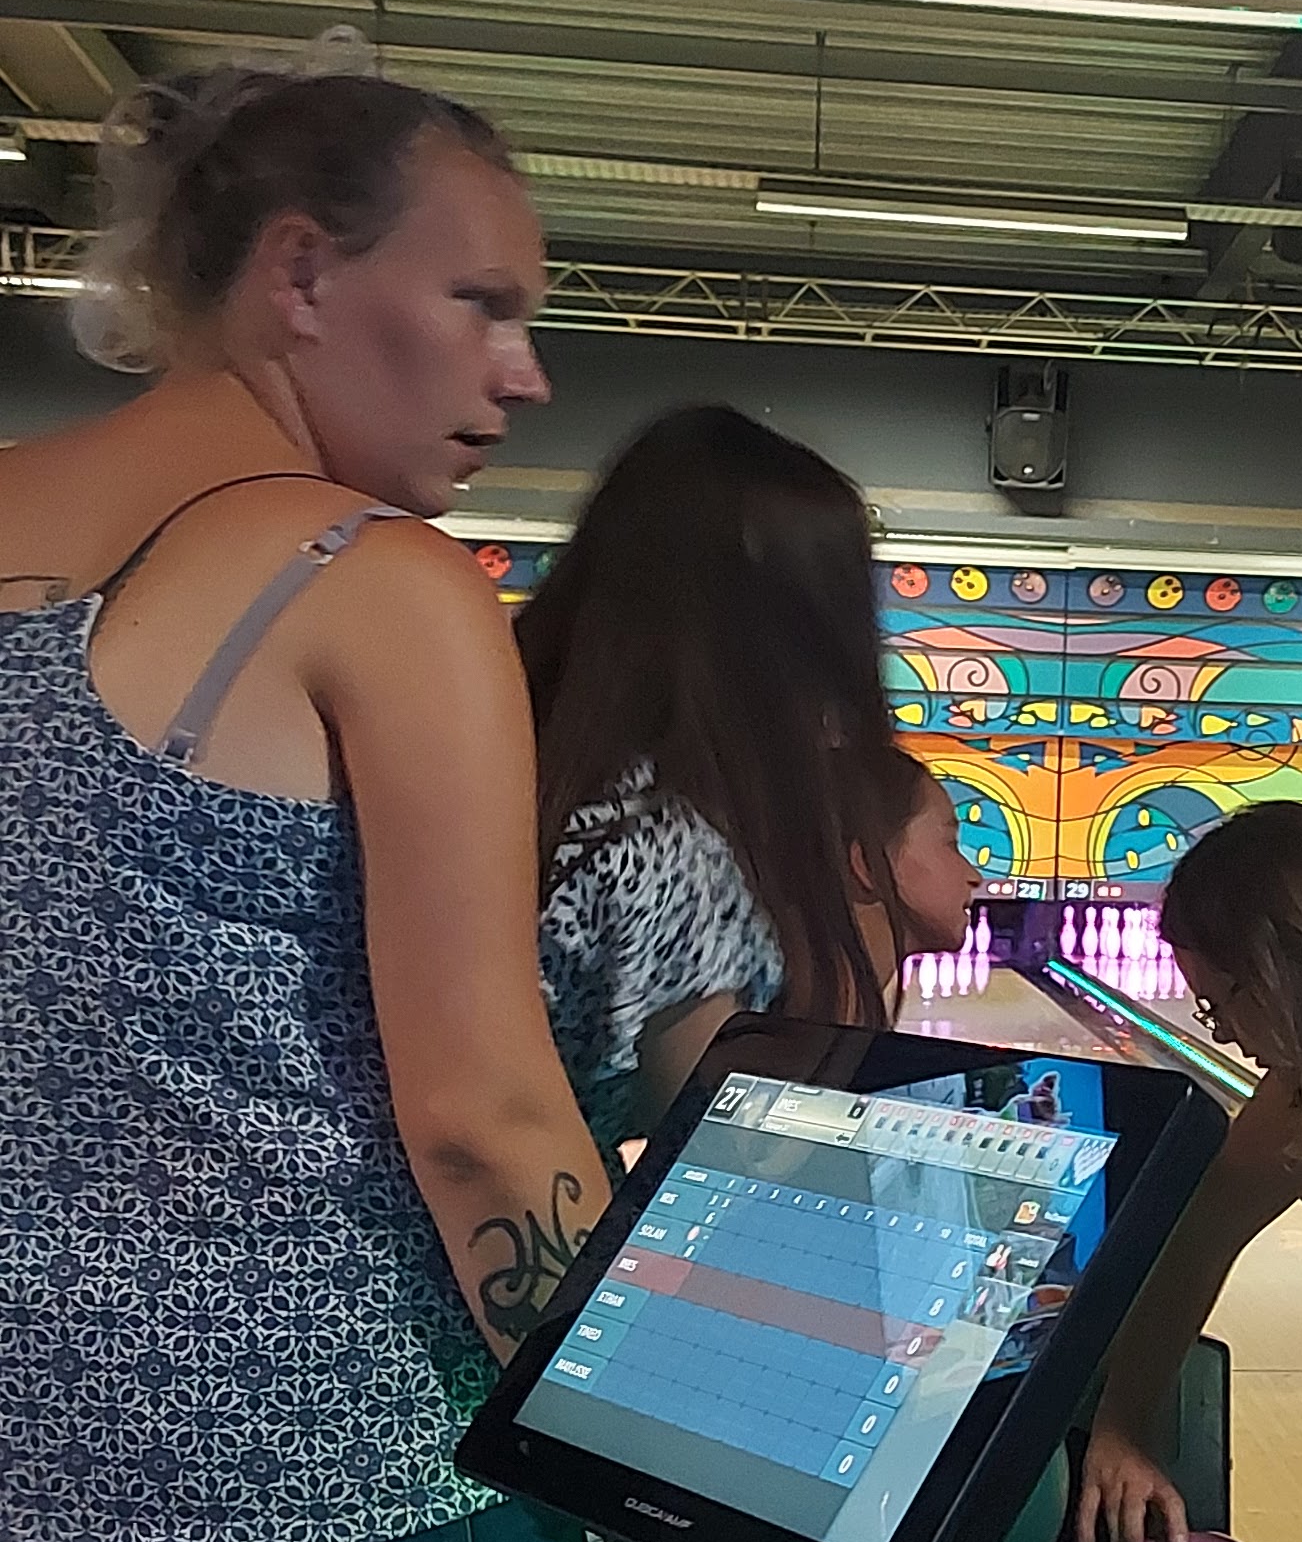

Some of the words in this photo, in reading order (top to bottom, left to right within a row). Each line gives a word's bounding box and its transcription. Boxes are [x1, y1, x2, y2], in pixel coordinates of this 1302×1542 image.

[1017, 881, 1041, 899] 28
[1066, 881, 1090, 899] 29
[715, 1086, 747, 1112] 27
[704, 1211, 716, 1224] 6
[747, 1183, 759, 1195] 2
[769, 1188, 781, 1200] 3
[793, 1194, 804, 1205] 4
[815, 1199, 827, 1210] 5
[839, 1205, 850, 1216] 6
[863, 1210, 874, 1221] 7
[914, 1221, 924, 1233] 9
[951, 1261, 968, 1279] 6
[928, 1298, 945, 1317] 8
[906, 1336, 922, 1355] 0
[883, 1375, 900, 1395] 0
[860, 1414, 877, 1434] 0
[837, 1454, 854, 1474] 0
